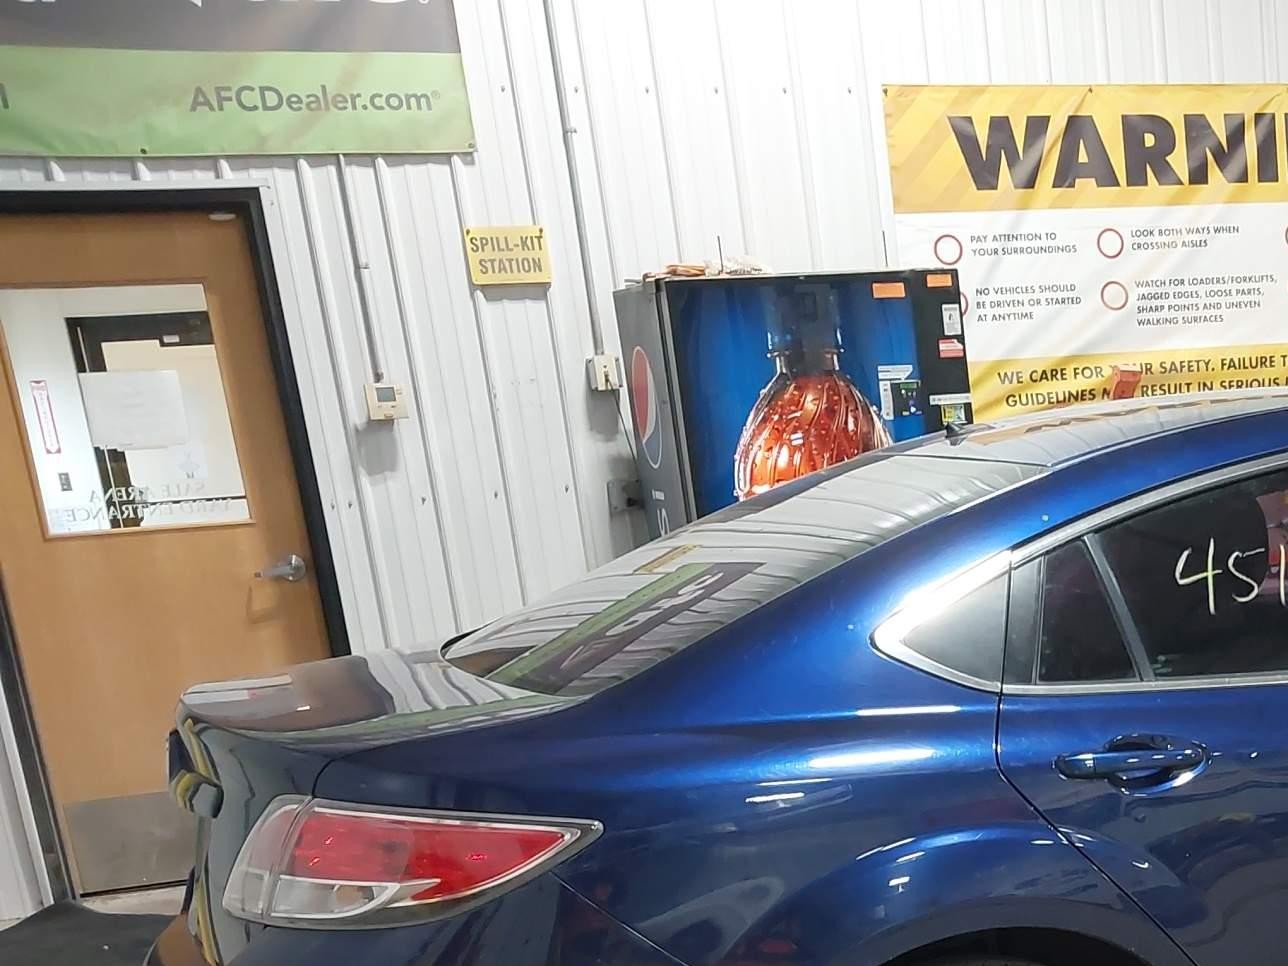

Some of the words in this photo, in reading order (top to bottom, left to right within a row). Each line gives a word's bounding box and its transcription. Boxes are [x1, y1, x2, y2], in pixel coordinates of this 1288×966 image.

[970, 235, 988, 244] PAY
[992, 233, 1042, 242] ATTENTION
[1045, 232, 1057, 241] TO
[1130, 228, 1155, 238] LOOK
[1158, 228, 1183, 237] BOTH
[1185, 226, 1211, 236] WAYS
[1213, 225, 1240, 234] WHEN
[469, 235, 543, 253] SPILL-KIT
[971, 247, 999, 256] YOUR
[1001, 245, 1078, 256] SURROUNDINGS
[1131, 240, 1178, 251] CROSSING
[1181, 239, 1208, 249] AISLES
[478, 257, 543, 275] STATION
[1134, 279, 1166, 289] WATCH
[1168, 278, 1186, 287] FOR
[1188, 274, 1278, 286] LOADERS/FORKLIFTS,
[976, 287, 990, 297] NO
[993, 285, 1036, 296] VEHICLES
[1039, 284, 1076, 294] SHOULD
[1136, 291, 1170, 302] JAGGED
[1172, 290, 1202, 300] EDGES,
[1204, 289, 1233, 298] LOOSE
[1235, 288, 1265, 297] PARTS,
[976, 300, 986, 310] BE
[990, 298, 1025, 309] DRIVEN
[1028, 298, 1042, 307] OR
[1044, 296, 1082, 306] STARTED
[1136, 304, 1165, 315] SHARP
[1168, 302, 1200, 313] POINTS
[1202, 302, 1222, 311] AND
[1225, 300, 1261, 310] UNEVEN
[977, 314, 988, 323] AT
[991, 312, 1034, 322] ANYTIME
[1136, 316, 1180, 328] WALKING
[1182, 314, 1224, 325] SURFACES
[998, 370, 1024, 386] WE
[1029, 367, 1068, 383] CARE
[1074, 366, 1105, 380] FOR
[1159, 358, 1216, 375] SAFETY.
[1220, 355, 1276, 372] FAILURE
[1005, 388, 1096, 408] GUIDELINES
[1140, 382, 1193, 398] RESULT
[1220, 376, 1280, 391] SERIOUS
